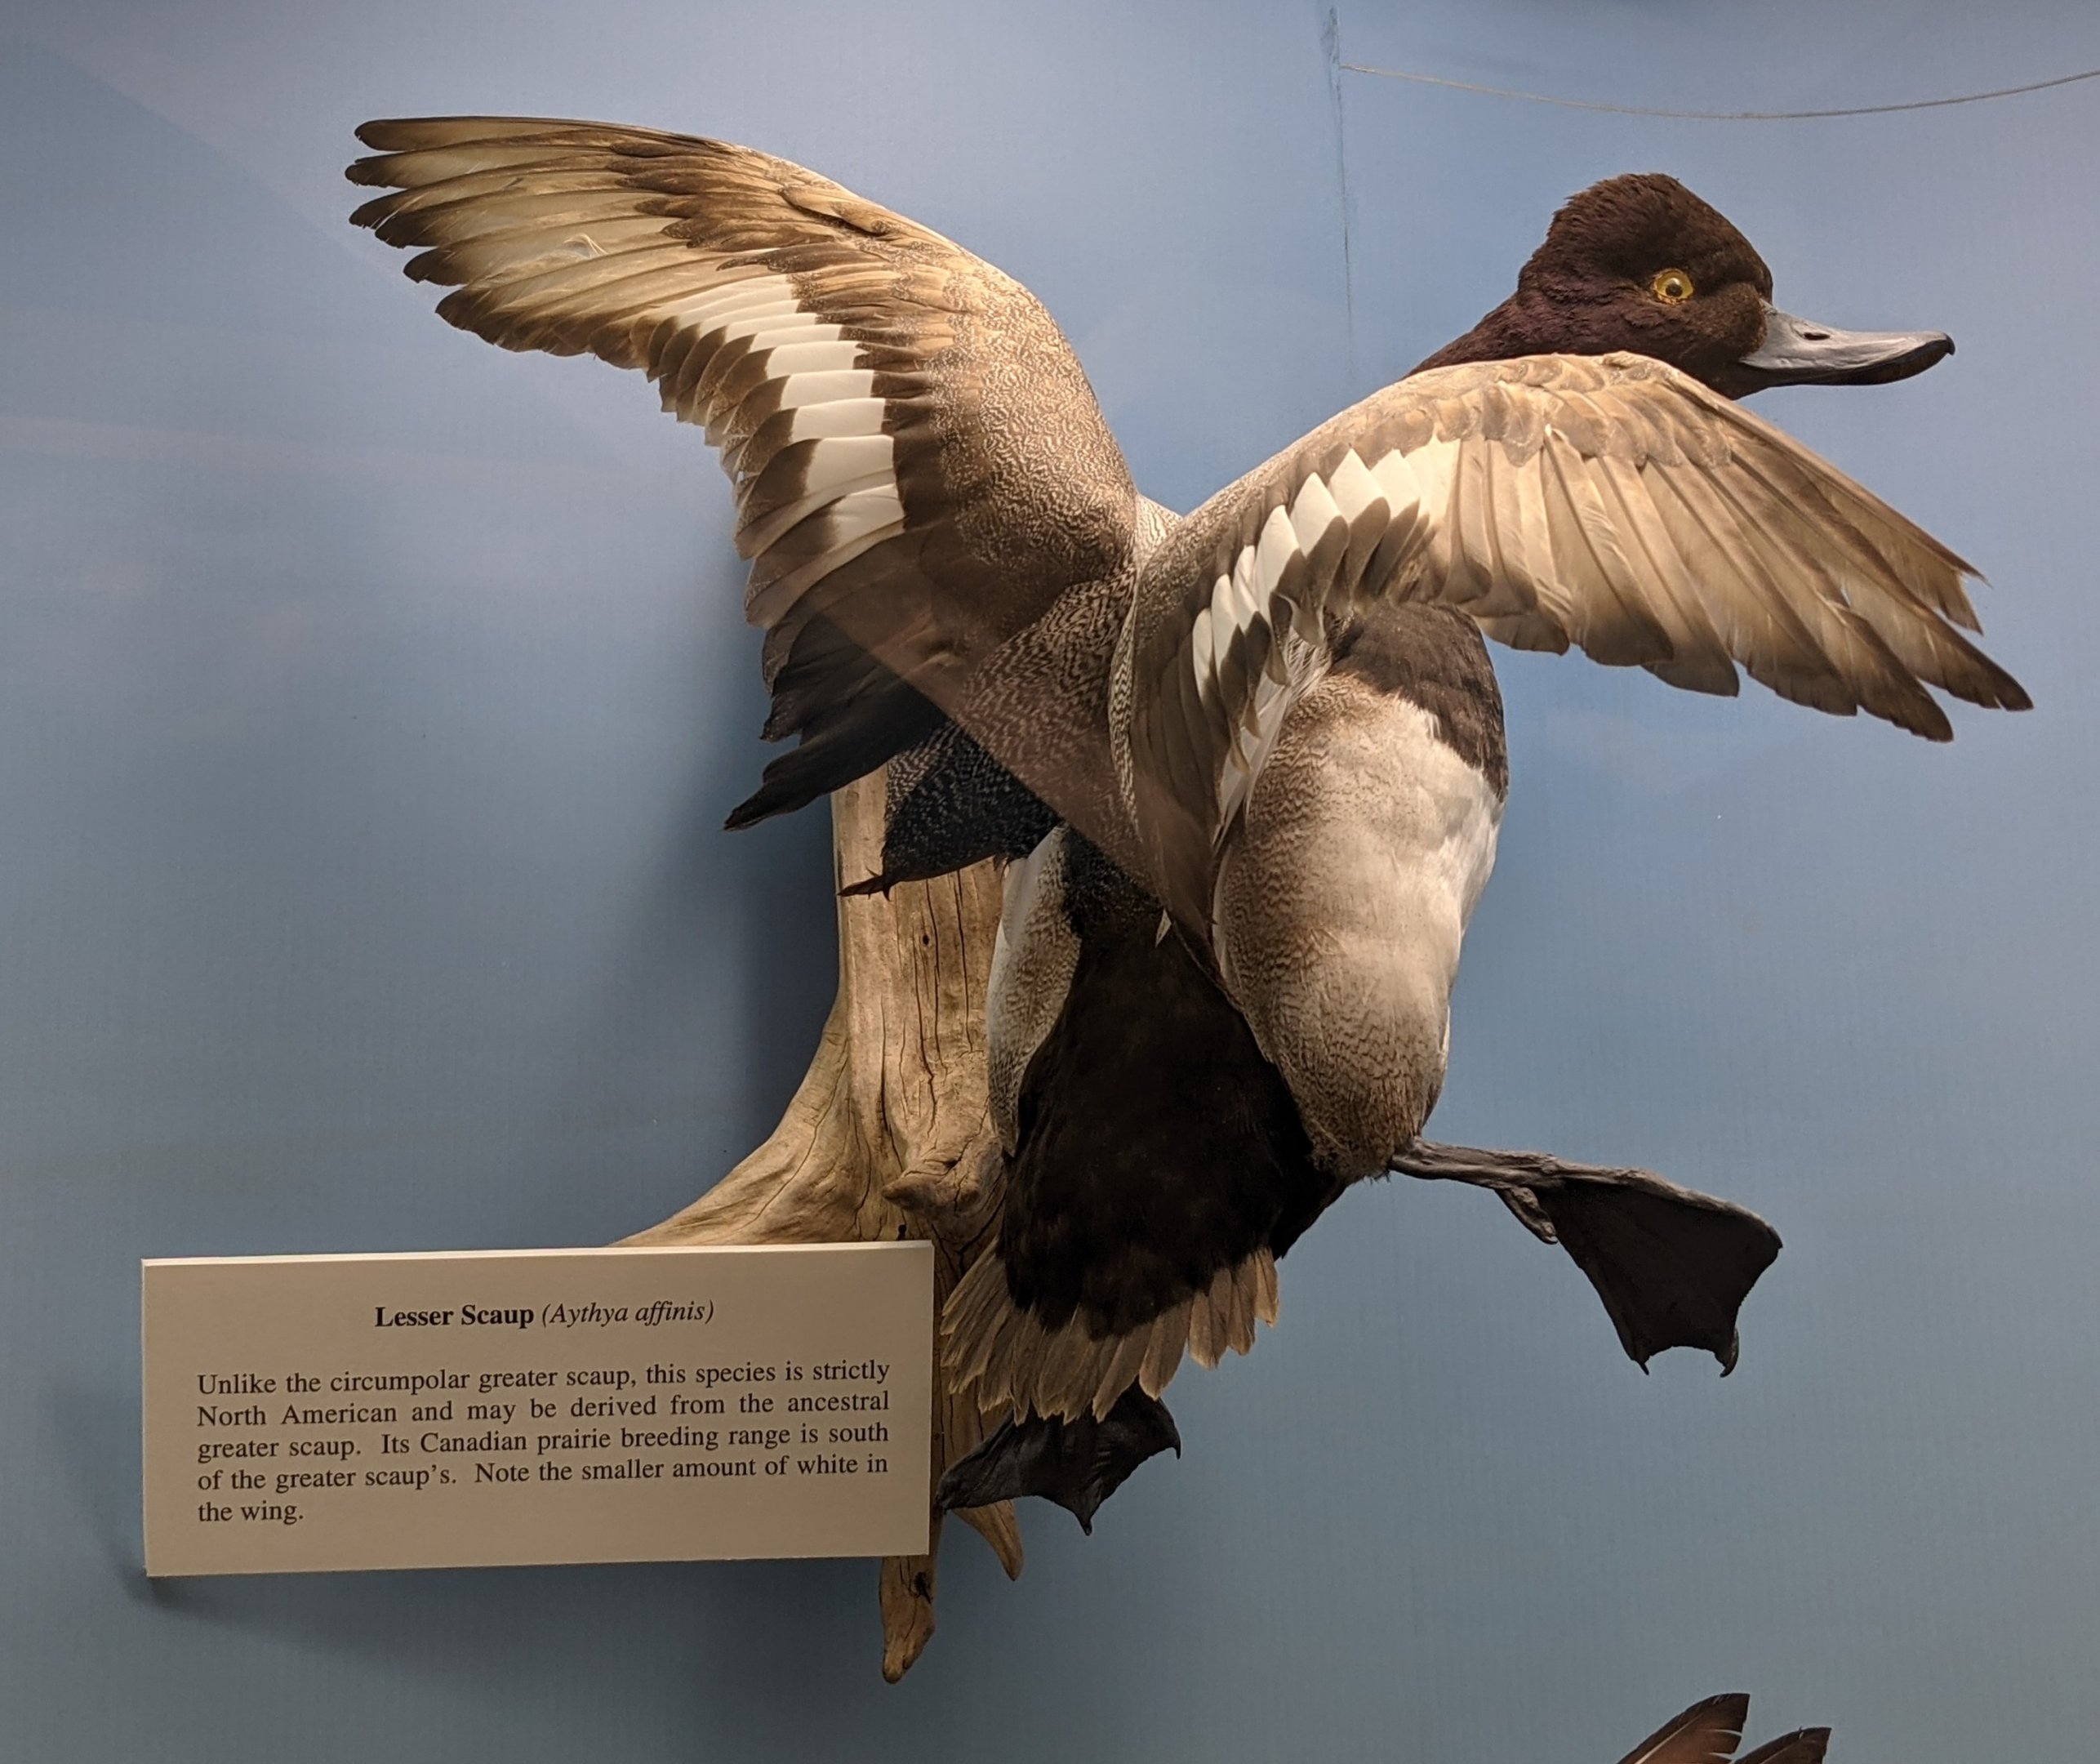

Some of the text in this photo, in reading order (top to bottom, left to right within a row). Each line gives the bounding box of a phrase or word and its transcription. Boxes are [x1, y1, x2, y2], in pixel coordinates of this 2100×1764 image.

[374, 1299, 714, 1330] Lesser Scaup (Aythya affinis)
[197, 1359, 891, 1396] Unlike the circumpolar greater scaup, this species is strictly
[197, 1390, 889, 1428] North American and may be derived from the ancestral
[197, 1421, 889, 1464] greater scaup. Its Canadian prairie breeding range is south
[198, 1453, 888, 1494] of the greater scaup's. Note the smaller amount of white in
[198, 1499, 304, 1526] the wing.
